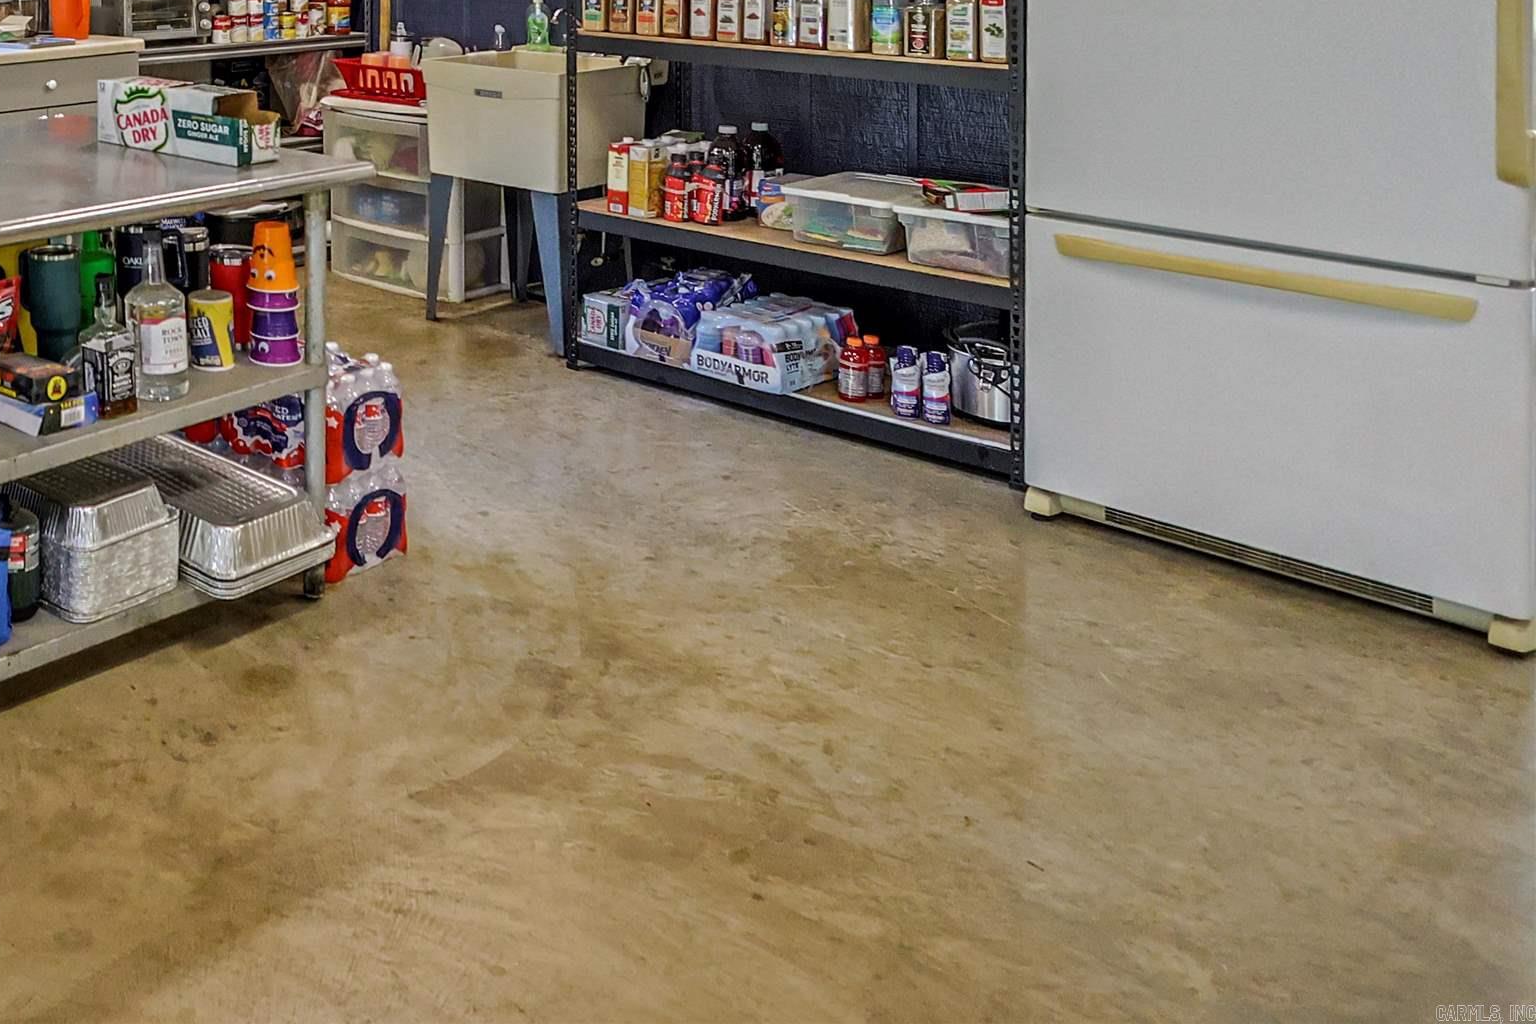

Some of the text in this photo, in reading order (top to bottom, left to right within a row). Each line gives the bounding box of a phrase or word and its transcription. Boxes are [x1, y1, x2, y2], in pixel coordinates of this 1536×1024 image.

[116, 106, 170, 132] CANADA
[176, 117, 199, 131] ZERO
[199, 121, 231, 136] SUGAR
[131, 127, 159, 145] DRY
[186, 130, 220, 142] GINGER ALE
[161, 327, 183, 337] ROCK
[162, 336, 184, 345] TOWN
[695, 353, 770, 385] BODYARMOR
